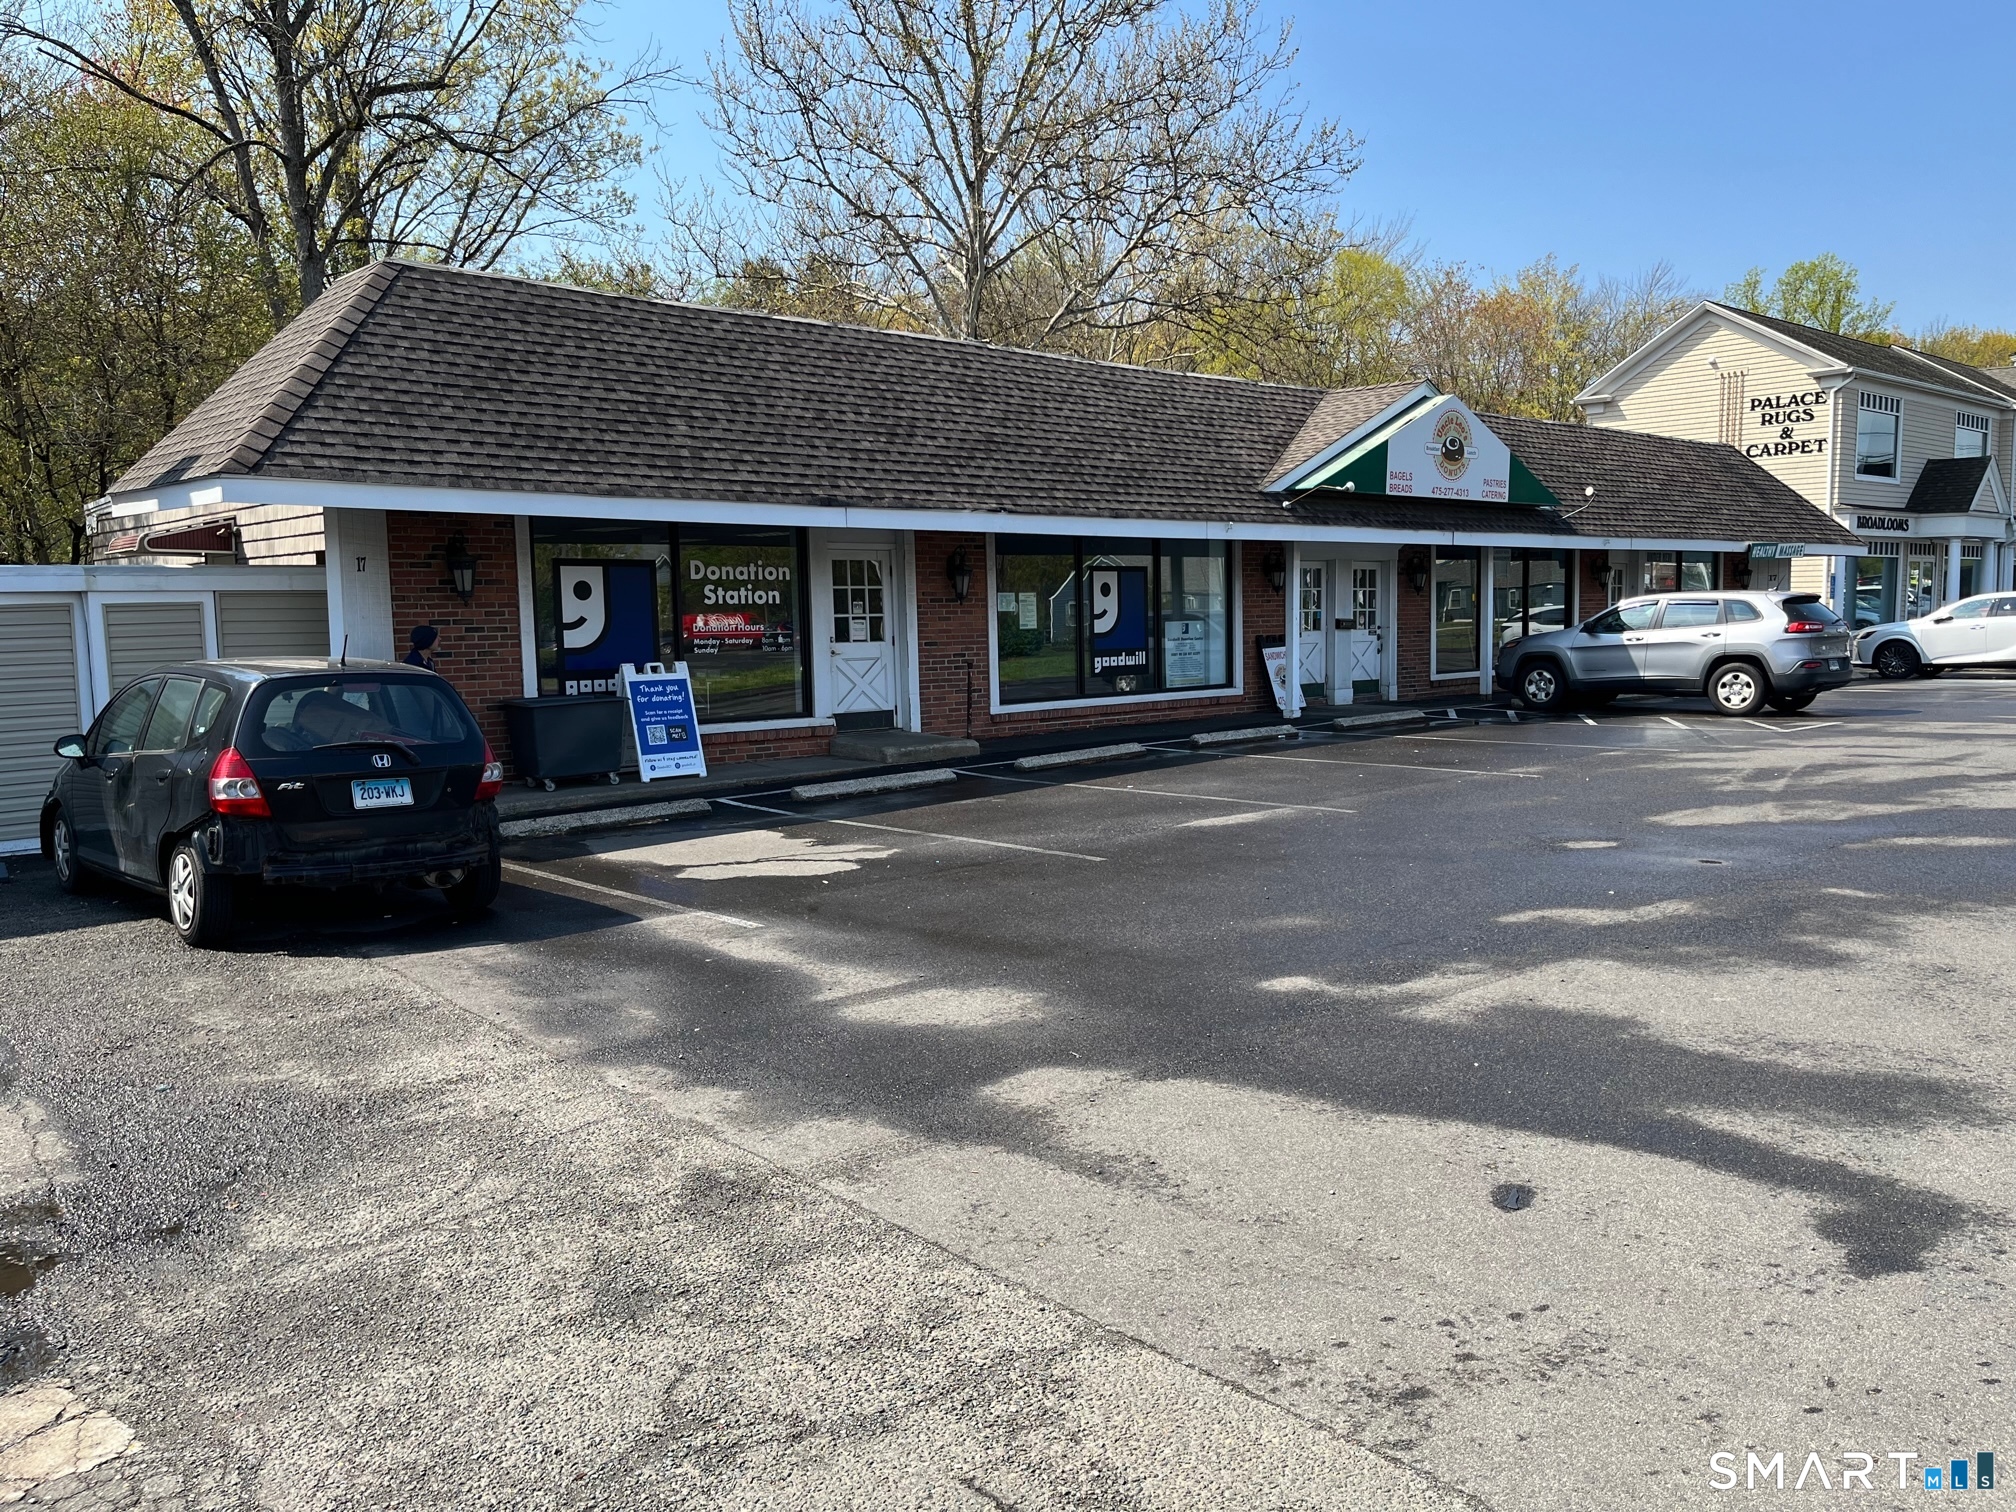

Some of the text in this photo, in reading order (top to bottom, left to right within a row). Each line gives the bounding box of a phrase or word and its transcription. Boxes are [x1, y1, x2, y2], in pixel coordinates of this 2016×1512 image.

[1750, 391, 1827, 411] PALACE
[1760, 408, 1815, 426] RUGS
[1437, 416, 1454, 438] Uncle
[1779, 427, 1794, 440] &
[1746, 438, 1828, 458] CARPET
[1439, 461, 1466, 477] DONUTS
[1389, 471, 1413, 481] BAGELS
[1389, 484, 1413, 493] BREADS
[1483, 479, 1507, 489] PASTRIES
[1431, 487, 1469, 497] 475-277-4313
[1482, 490, 1506, 500] CATERING
[1856, 515, 1910, 531] BROADLOOMS
[1778, 545, 1804, 556] MASSAGE
[356, 556, 366, 572] 17
[690, 560, 791, 580] Donation
[703, 583, 780, 605] Station
[692, 623, 765, 632] Donation Hours
[693, 638, 720, 646] Monday
[694, 647, 719, 655] Sunday
[781, 645, 793, 653] 6pm
[1094, 651, 1146, 674] goodwill
[565, 673, 619, 695] good
[639, 684, 679, 693] Thank you
[652, 691, 685, 703] donating!
[277, 782, 305, 791] Fit
